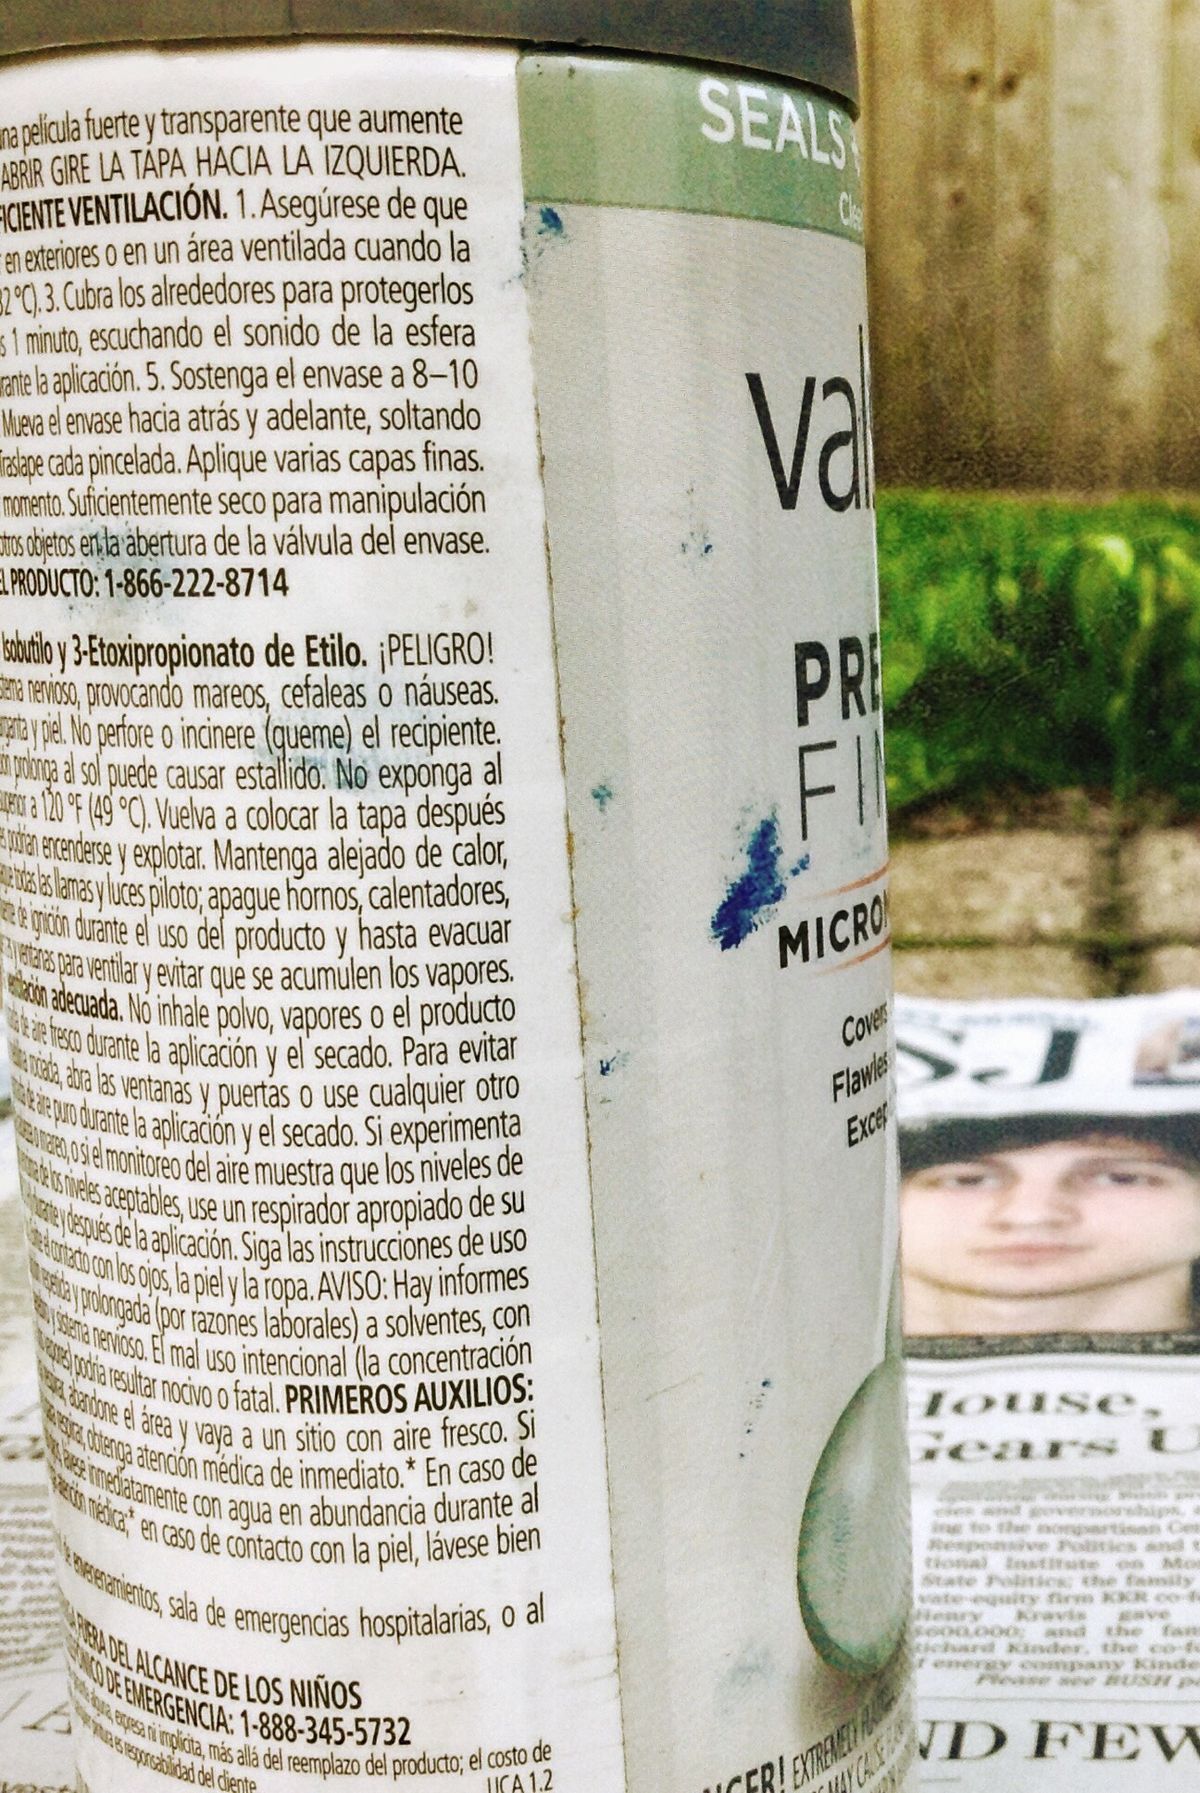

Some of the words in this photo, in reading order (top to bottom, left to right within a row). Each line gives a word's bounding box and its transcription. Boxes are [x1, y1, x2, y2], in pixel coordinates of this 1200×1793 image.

[160, 105, 300, 142] transparente
[308, 109, 351, 141] que
[359, 107, 463, 135] aumente
[699, 77, 846, 170] SEALS
[197, 145, 272, 176] HACIA
[283, 145, 313, 175] LA
[325, 145, 466, 180] IZQUIERDA.
[68, 183, 227, 226] VENTILACIÓN.
[237, 189, 255, 218] 1.
[261, 187, 380, 227] Asegúrese
[241, 229, 345, 261] ventilada
[355, 230, 441, 262] cuando
[152, 272, 275, 306] alrededores
[283, 281, 333, 312] para
[341, 272, 473, 312] protegerlos
[90, 317, 202, 351] escuchando
[214, 315, 231, 347] el
[244, 314, 319, 346] sonido
[171, 360, 268, 397] Sostenga
[276, 357, 294, 388] el
[303, 366, 383, 388] envase
[391, 366, 404, 388] a
[267, 399, 371, 435] adelante,
[380, 399, 481, 430] soltando
[274, 442, 341, 472] varias
[349, 450, 416, 480] capas
[422, 440, 484, 472] finas.
[218, 492, 266, 514] seco
[273, 492, 322, 522] para
[330, 482, 486, 521] manipulación
[273, 524, 353, 555] válvula
[361, 524, 395, 555] del
[404, 532, 489, 554] envase.
[10, 568, 99, 597] PRODUCTO:
[105, 568, 289, 598] 1-866-222-8714
[72, 634, 254, 676] 3-Etoxipropionato
[306, 632, 367, 667] Etilo.
[380, 632, 493, 674] ¡PELIGRO!
[282, 674, 366, 708] cefaleas
[405, 673, 498, 706] náuseas.
[265, 715, 351, 759] (queme)
[392, 714, 500, 755] recipiente.
[379, 763, 472, 797] exponga
[357, 802, 406, 837] tapa
[417, 793, 505, 835] después
[214, 839, 317, 880] Mantenga
[328, 836, 405, 878] alejado
[286, 878, 362, 915] hornos,
[369, 873, 509, 910] calentadores,
[359, 918, 416, 950] hasta
[429, 920, 511, 947] evacuar
[281, 957, 381, 990] acumulen
[390, 956, 419, 988] los
[426, 959, 513, 994] vapores.
[281, 1006, 361, 1038] vapores
[421, 993, 515, 1035] producto
[403, 1036, 448, 1066] Para
[459, 1031, 517, 1063] evitar
[370, 1073, 465, 1116] cualquier
[477, 1073, 519, 1101] otro
[282, 1115, 358, 1147] secado.
[391, 1111, 521, 1155] experimenta
[421, 1148, 491, 1182] niveles
[252, 1192, 350, 1235] respirador
[357, 1188, 462, 1234] apropiado
[320, 1231, 452, 1262] instrucciones
[490, 1229, 527, 1254] uso
[318, 1270, 387, 1300] AVISO:
[394, 1269, 432, 1306] Hay
[439, 1263, 529, 1296] informes
[386, 1305, 485, 1337] solventes,
[493, 1304, 530, 1329] con
[243, 1344, 346, 1377] intencional
[356, 1345, 379, 1381] (la
[389, 1335, 532, 1375] concentración
[285, 1383, 407, 1414] PRIMEROS
[414, 1373, 534, 1413] AUXILIOS:
[394, 1421, 431, 1451] aire
[441, 1416, 507, 1448] fresco.
[459, 1458, 504, 1484] caso
[310, 1496, 425, 1526] abundancia
[434, 1492, 513, 1523] durante
[378, 1532, 419, 1572] piel,
[427, 1531, 488, 1561] lávese
[497, 1524, 540, 1554] bien
[235, 1608, 349, 1643] emergencias
[360, 1603, 490, 1645] hospitalarias,
[133, 1649, 209, 1699] ALCANCE
[214, 1670, 239, 1700] DE
[245, 1675, 283, 1705] LOS
[290, 1674, 362, 1709] NIÑOS
[121, 1674, 237, 1735] EMERGENCIA:
[241, 1710, 411, 1745] 1-888-345-5732
[393, 1752, 463, 1781] producto;
[488, 1747, 527, 1768] costo
